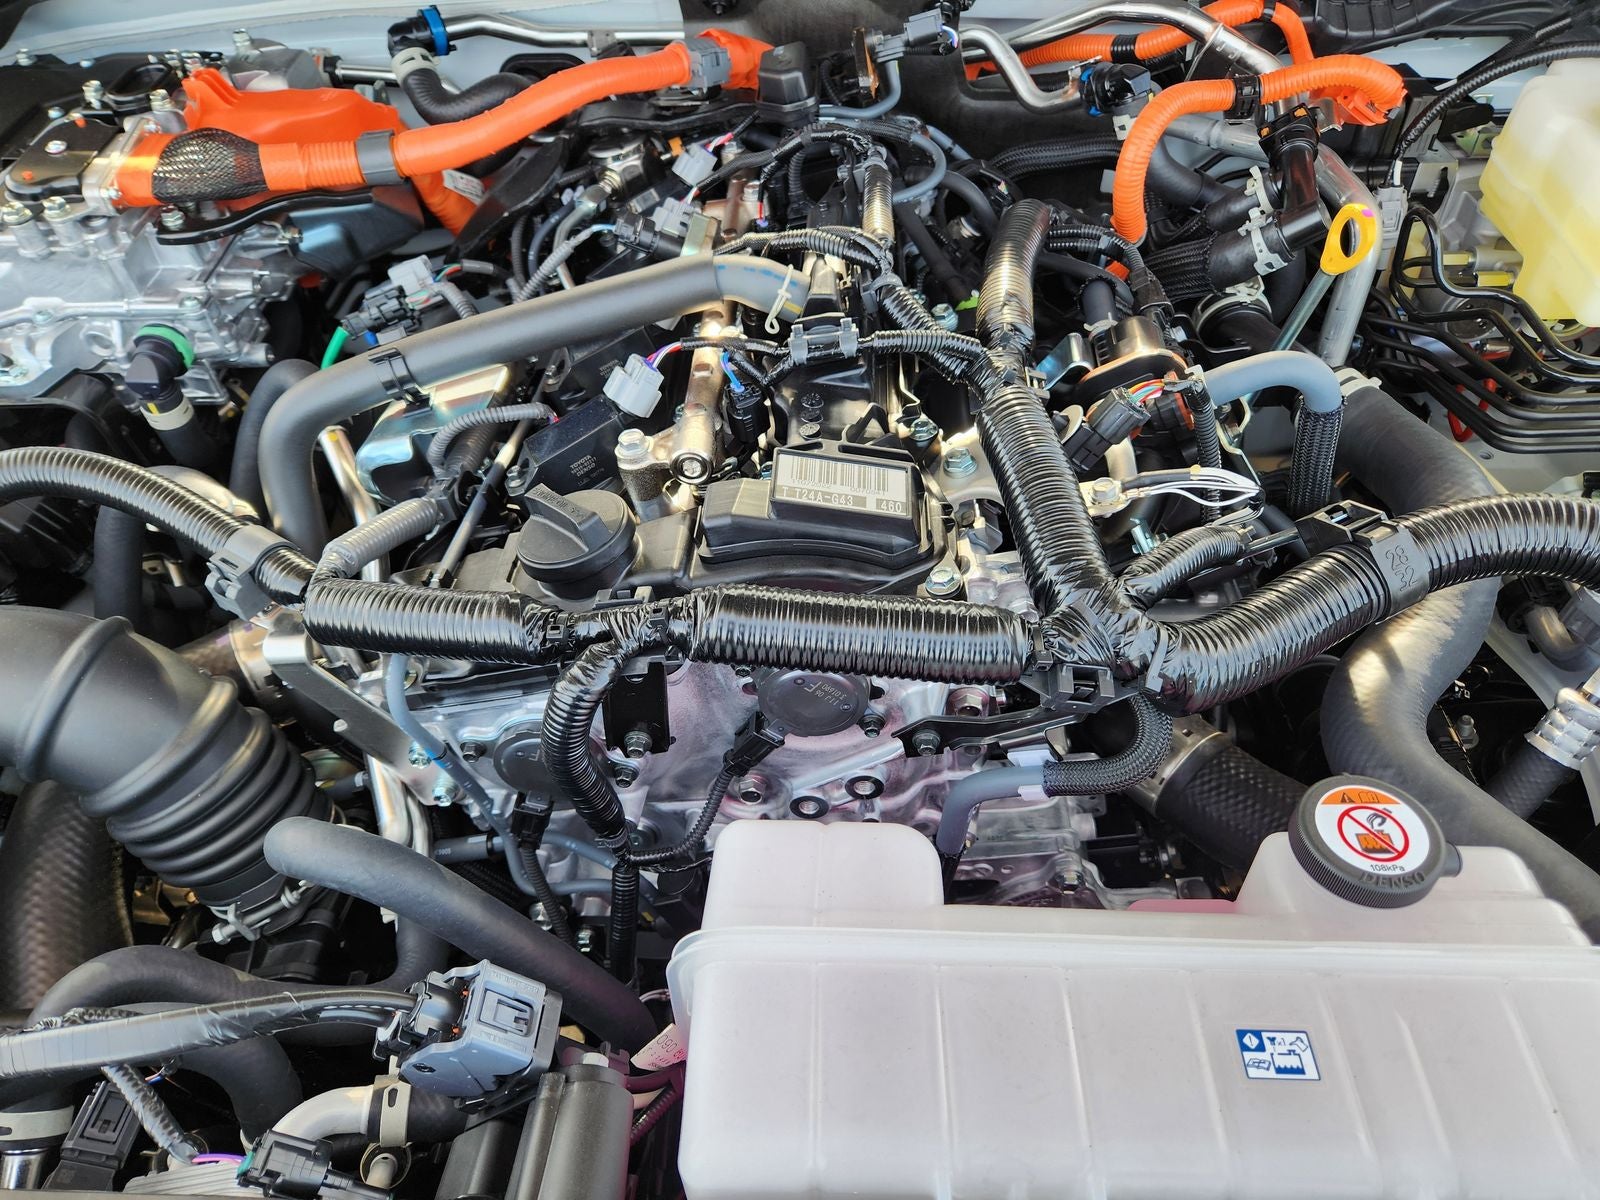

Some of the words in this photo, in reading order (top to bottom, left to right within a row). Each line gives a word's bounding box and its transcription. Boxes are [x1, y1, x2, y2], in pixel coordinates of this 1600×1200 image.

[782, 486, 790, 498] T
[795, 487, 853, 507] T24A-G43
[880, 500, 902, 513] 460
[1385, 545, 1409, 571] 28
[1395, 565, 1419, 592] 32
[803, 680, 822, 693] F
[1370, 863, 1405, 872] 108kPa
[1359, 871, 1426, 889] DENSO
